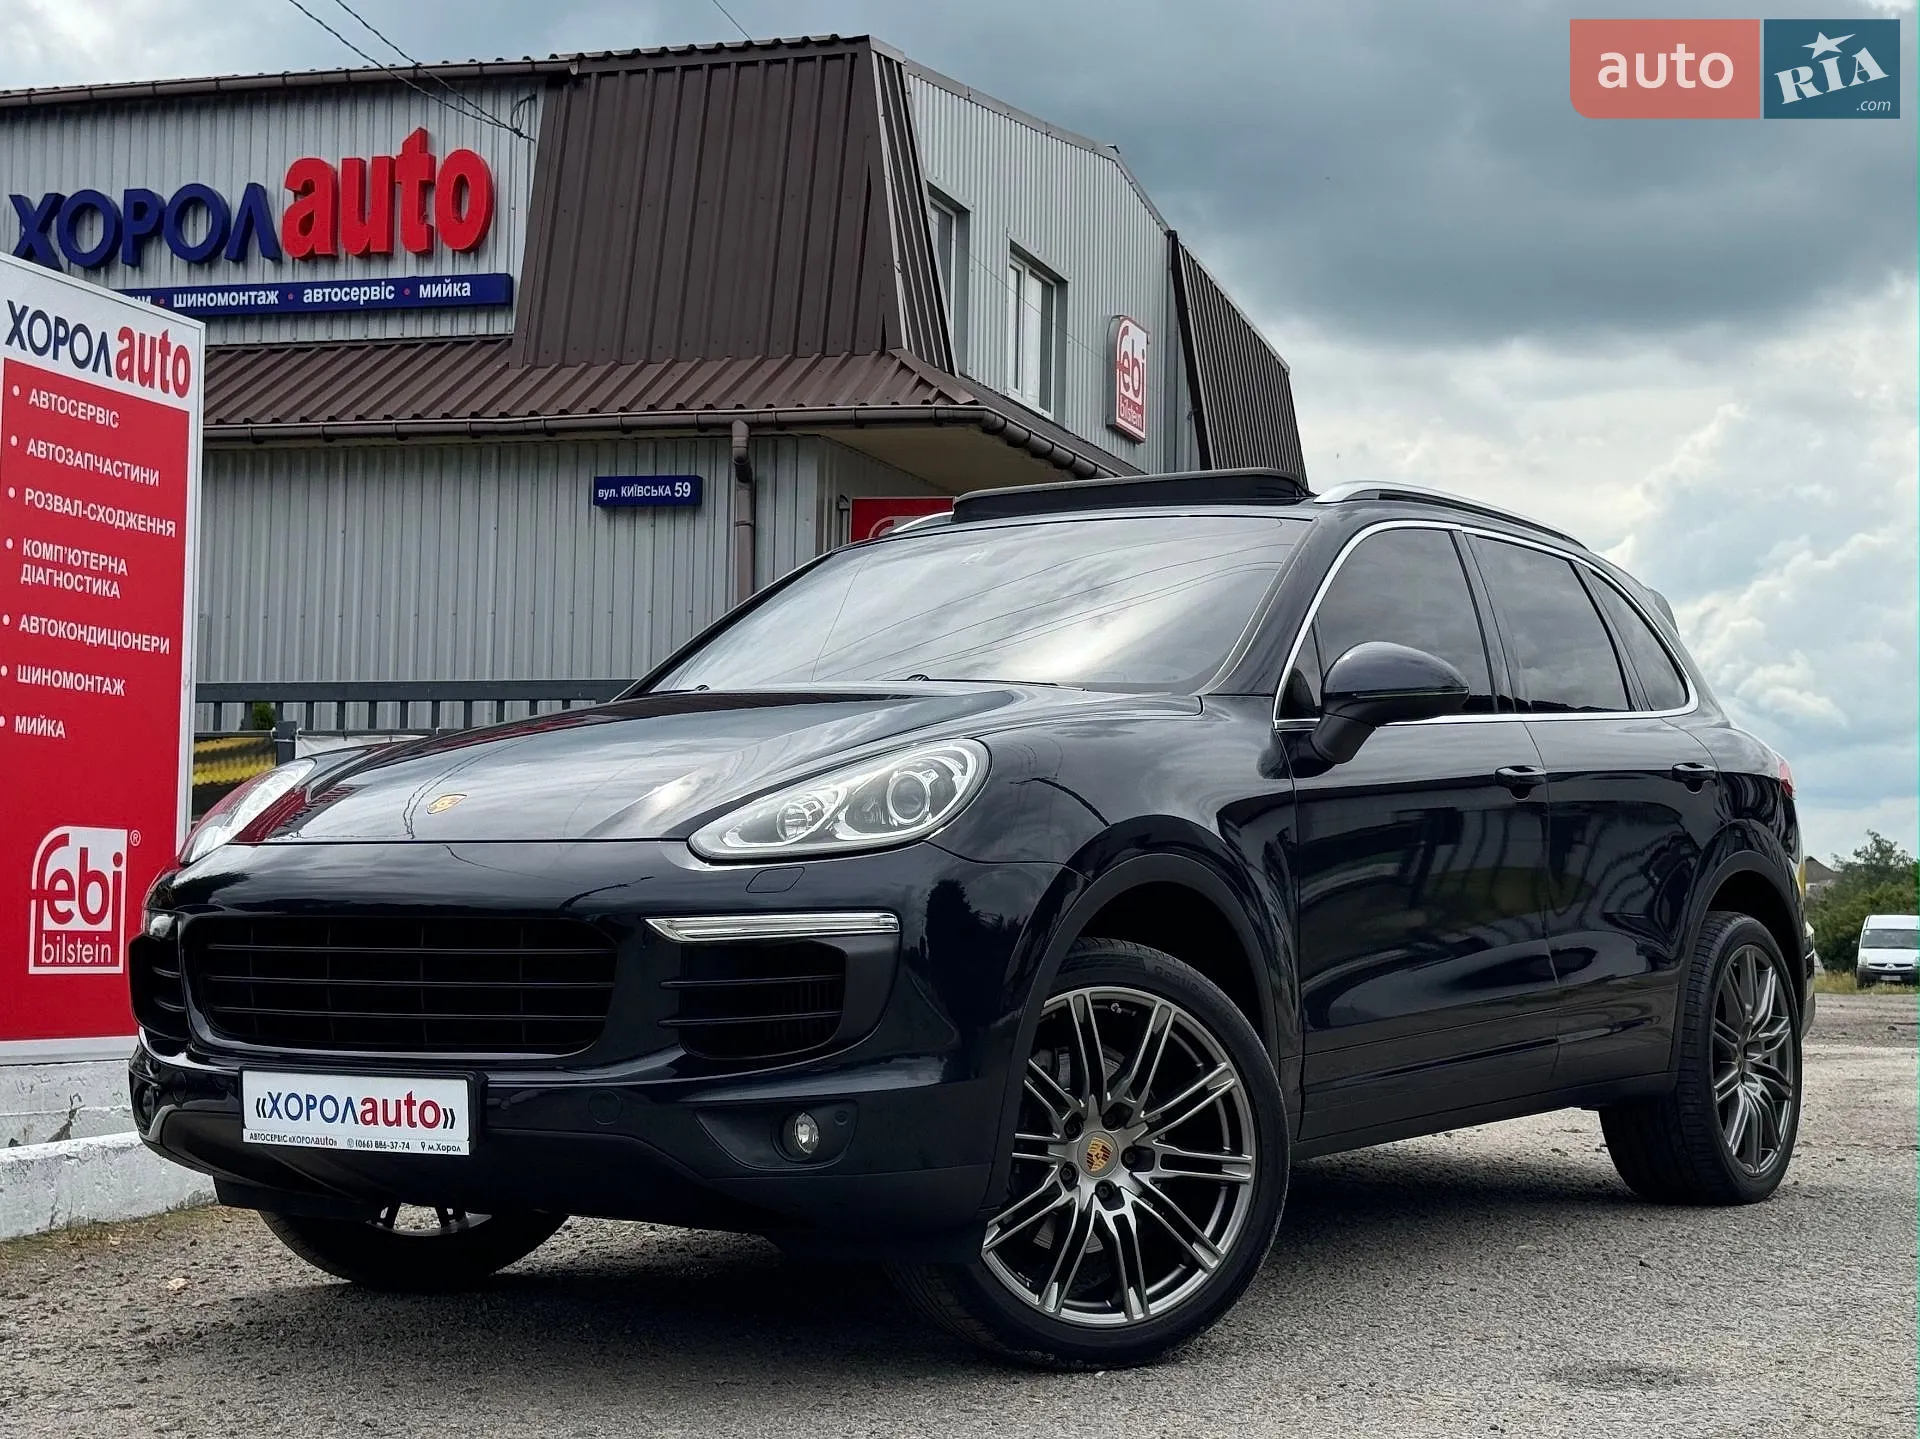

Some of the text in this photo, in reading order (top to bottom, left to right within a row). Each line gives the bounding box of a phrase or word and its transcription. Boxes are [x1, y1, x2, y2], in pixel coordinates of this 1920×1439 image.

[173, 289, 279, 308] шиномонтаж
[303, 281, 395, 305] автосервіс
[419, 278, 472, 298] мийка
[1116, 325, 1145, 400] febi
[28, 388, 120, 428] АВТОСЕРВІС
[26, 438, 160, 487] АВТОЗАПЧАСТИНИ
[598, 482, 691, 500] вул. КИЇВСЬКА 59
[25, 488, 177, 538] РОЗВАЛ-СХОДЖЕННЯ
[20, 564, 121, 599] ДІАГНОСТИКА
[18, 614, 170, 655] АВТОКОНДИЦІОНЕРИ
[16, 664, 126, 696] ШИНОМОНТАЖ
[15, 714, 66, 739] МИЙКА
[31, 833, 123, 936] febi
[41, 933, 112, 964] bilstein
[249, 1132, 287, 1143] АВТОСЕРВІС
